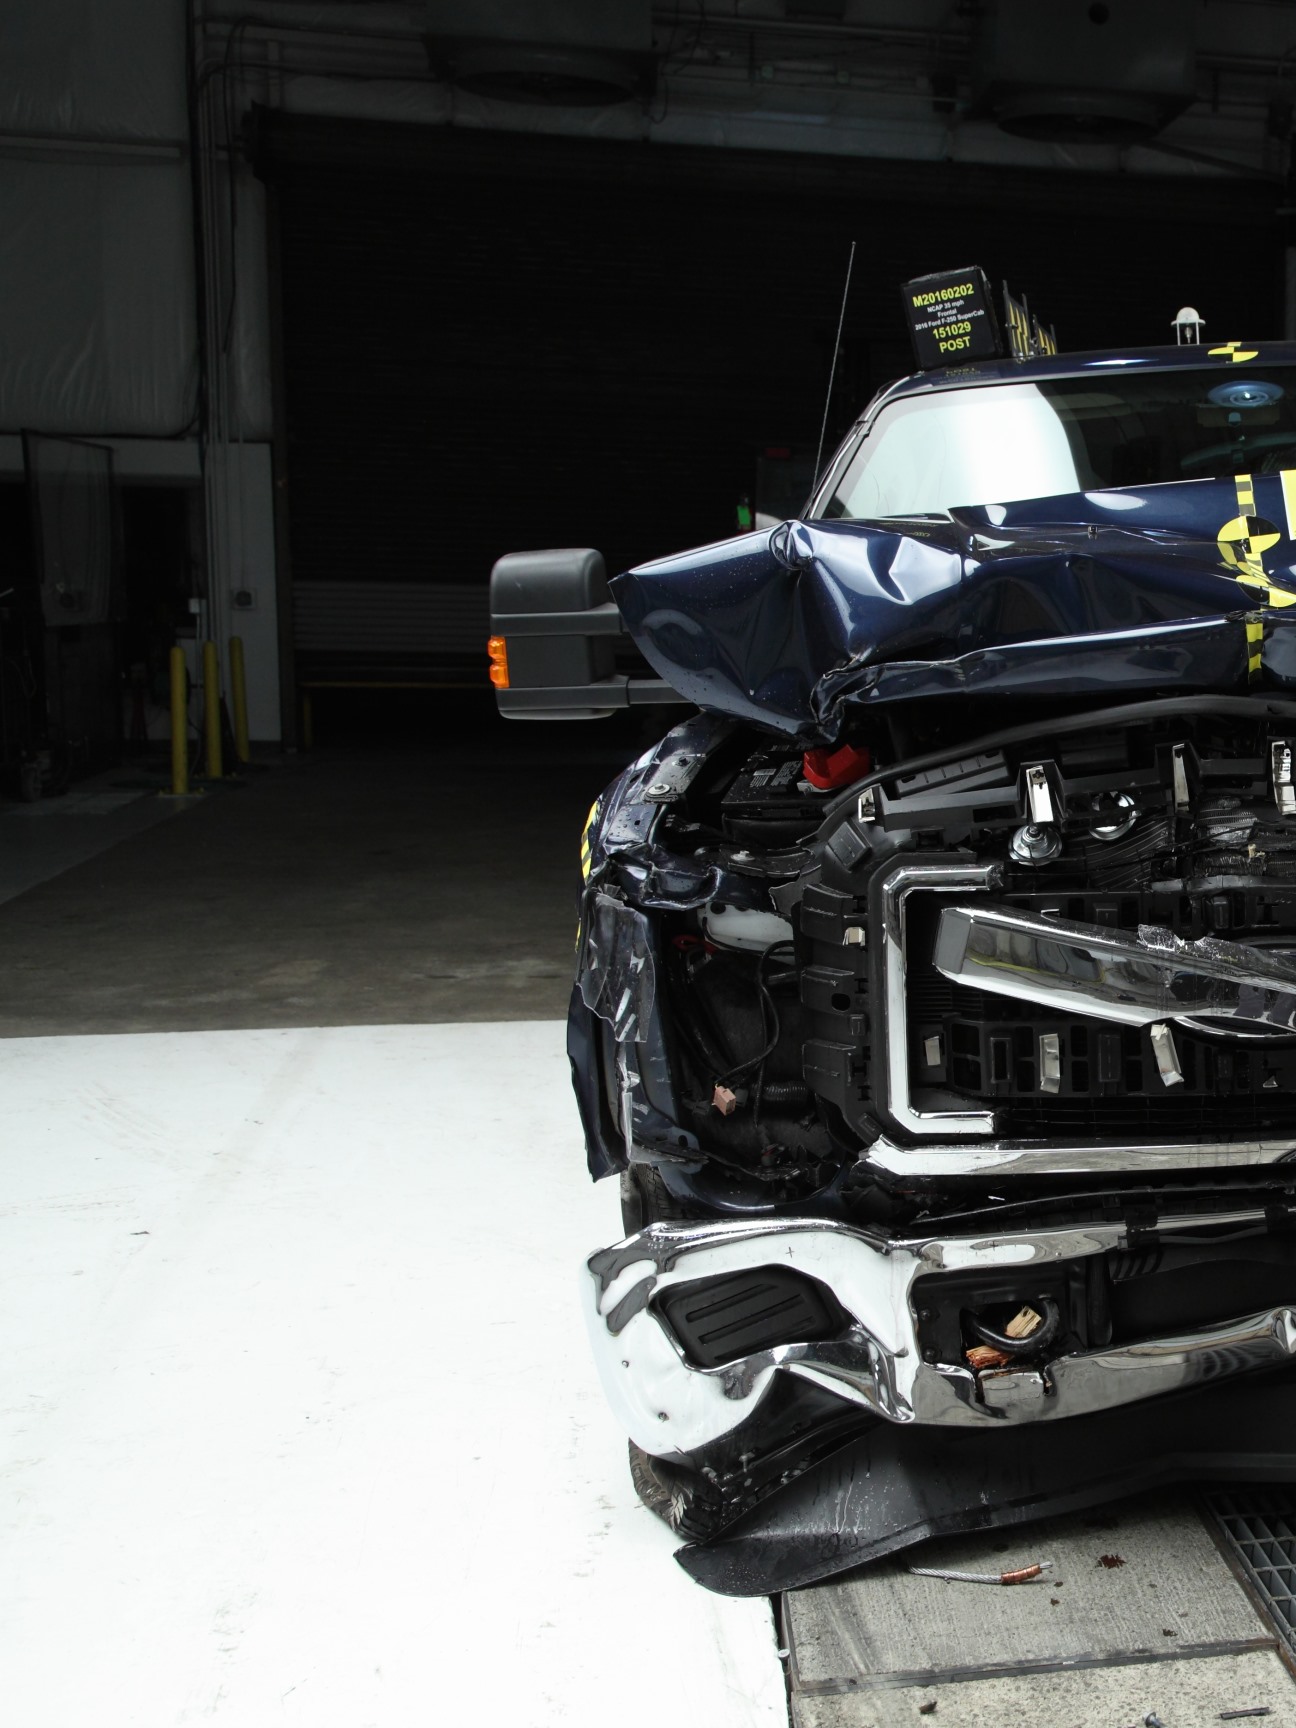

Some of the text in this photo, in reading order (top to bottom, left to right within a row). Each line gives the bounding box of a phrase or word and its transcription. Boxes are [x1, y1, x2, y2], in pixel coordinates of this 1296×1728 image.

[912, 283, 975, 308] M20160202
[927, 304, 943, 313] NCAP
[937, 308, 957, 317] Frontal
[915, 309, 984, 330] 2016 Ford F-250 SuperCab
[933, 321, 971, 339] 151029
[939, 336, 971, 353] POST
